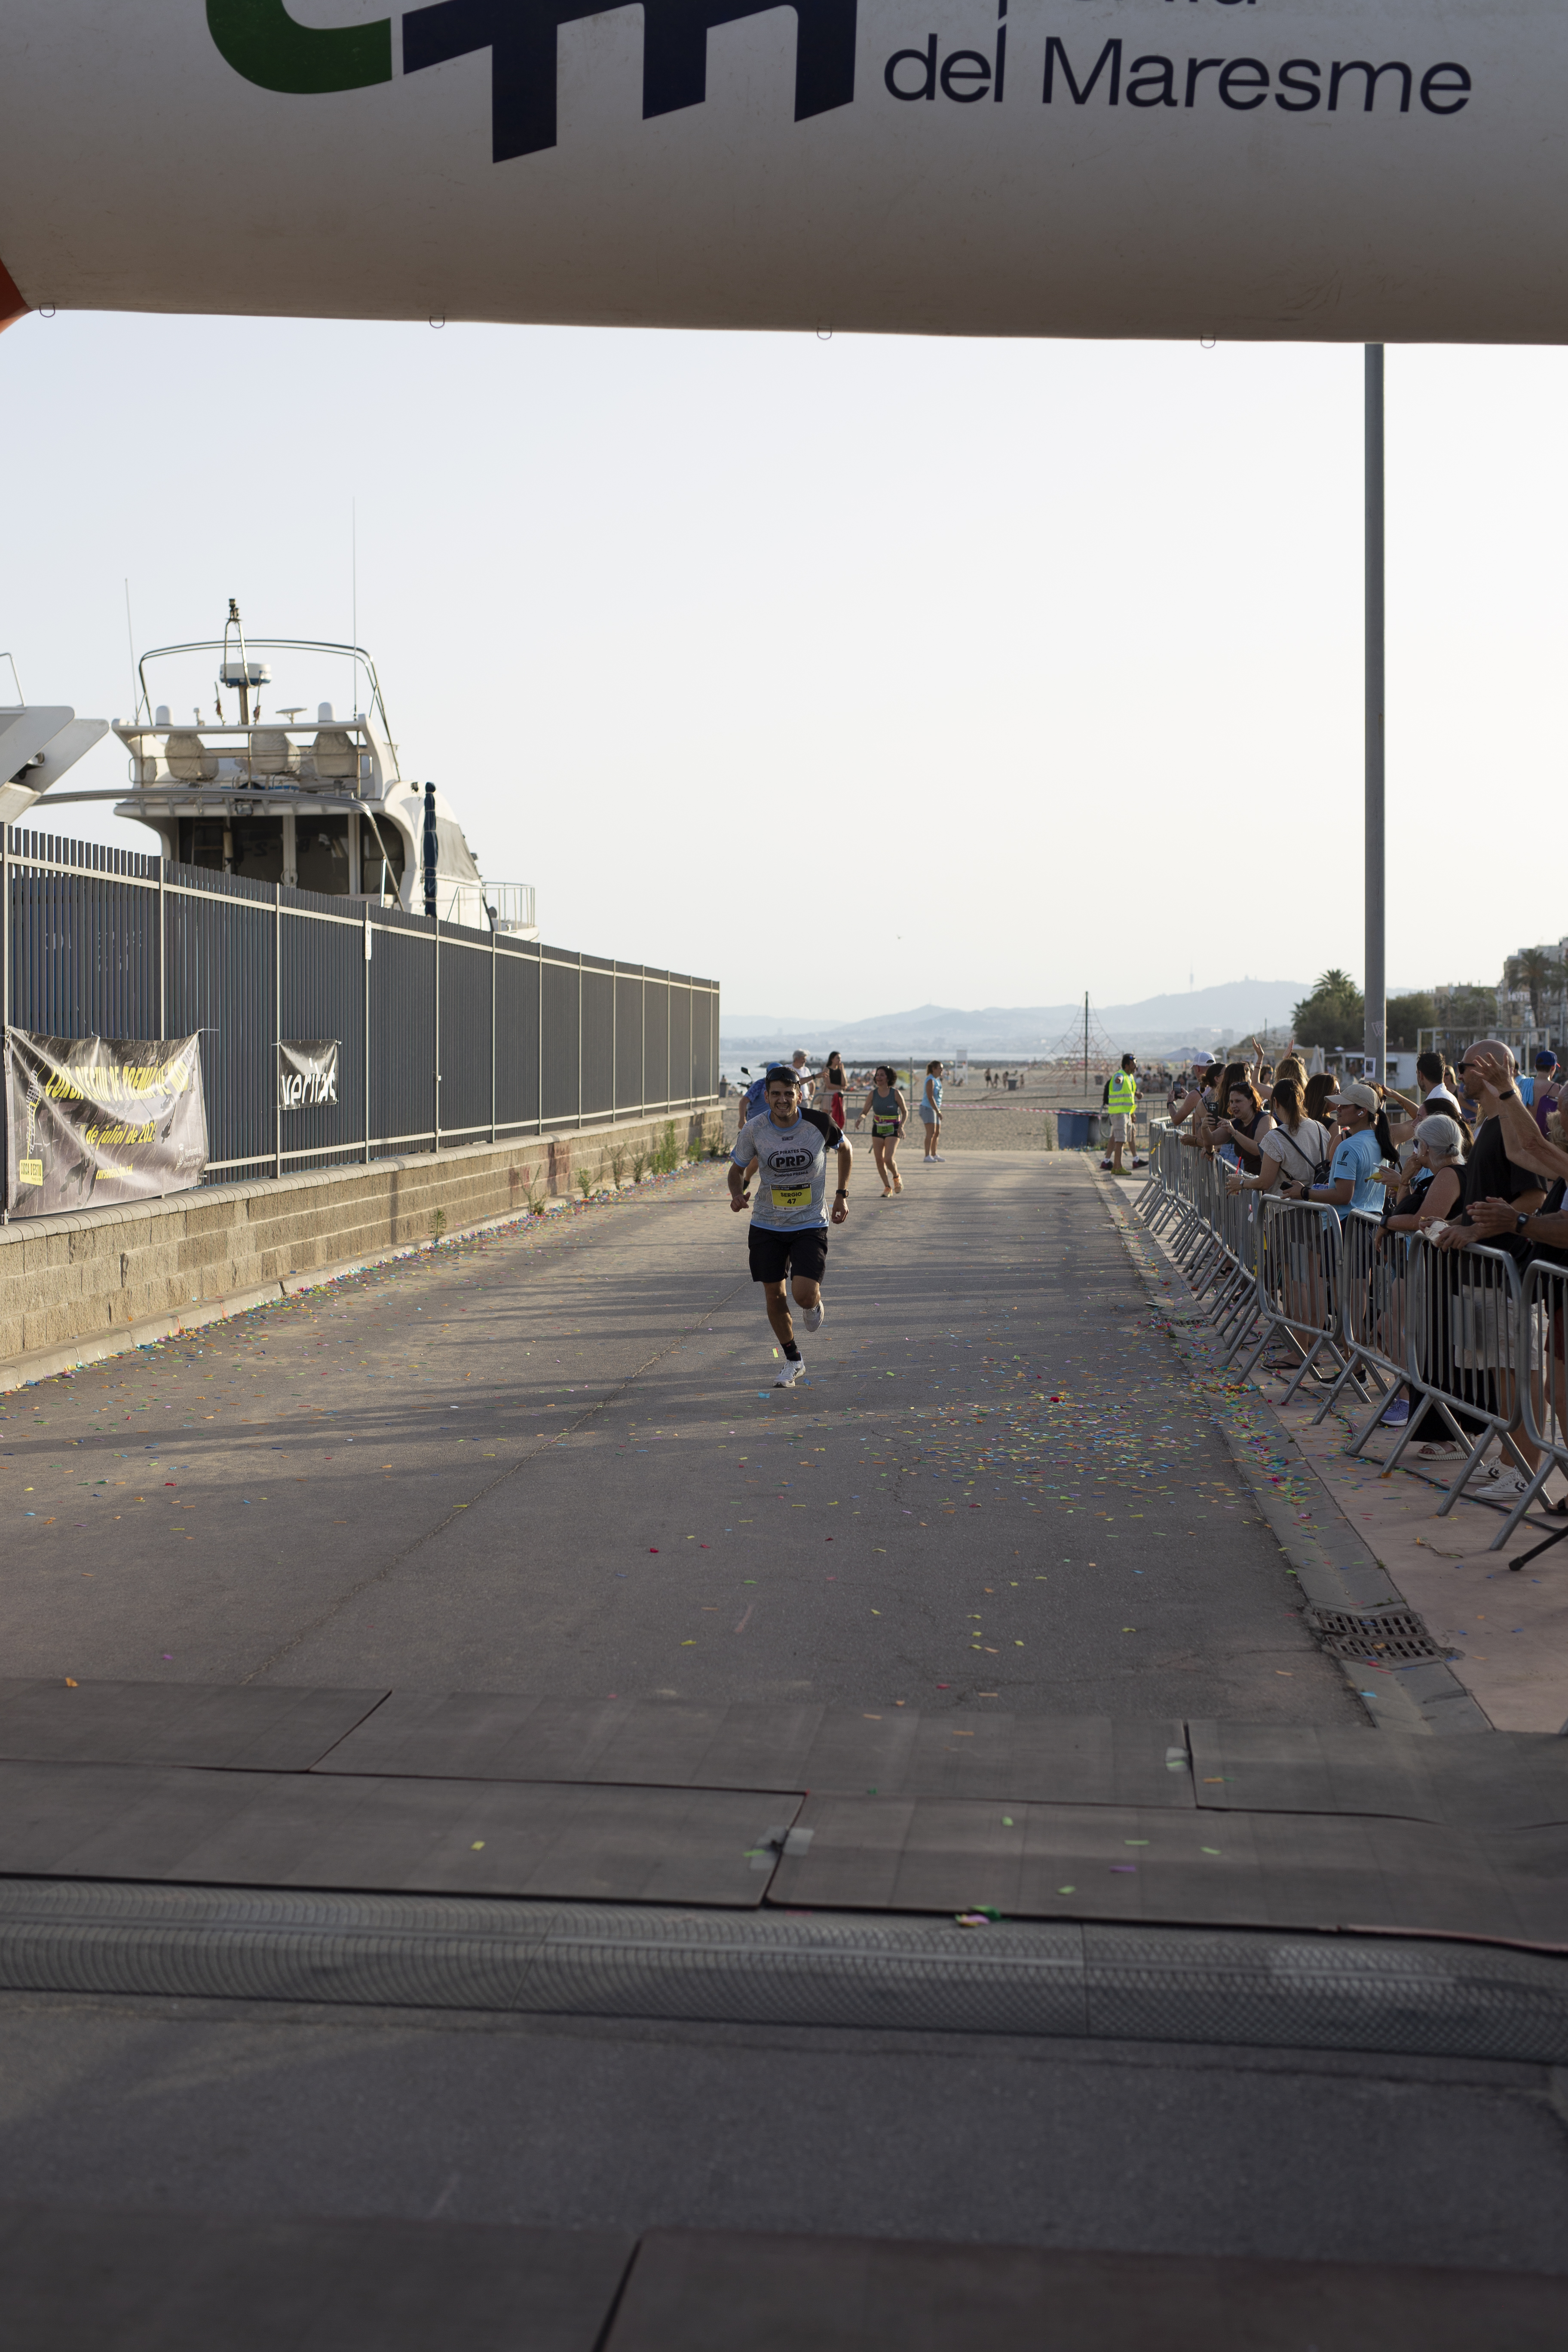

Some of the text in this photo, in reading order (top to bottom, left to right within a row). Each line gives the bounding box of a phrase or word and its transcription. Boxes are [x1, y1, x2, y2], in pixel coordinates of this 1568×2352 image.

[884, 23, 1472, 115] del Maresme
[1507, 991, 1531, 1002] HOTE
[109, 1066, 123, 1101] DE
[155, 1063, 172, 1096] DE
[86, 1124, 99, 1145] de
[95, 1124, 129, 1151] juliol
[126, 1124, 138, 1144] de
[21, 1162, 41, 1177] CURSA D'ESTIU
[775, 1155, 805, 1168] PRP
